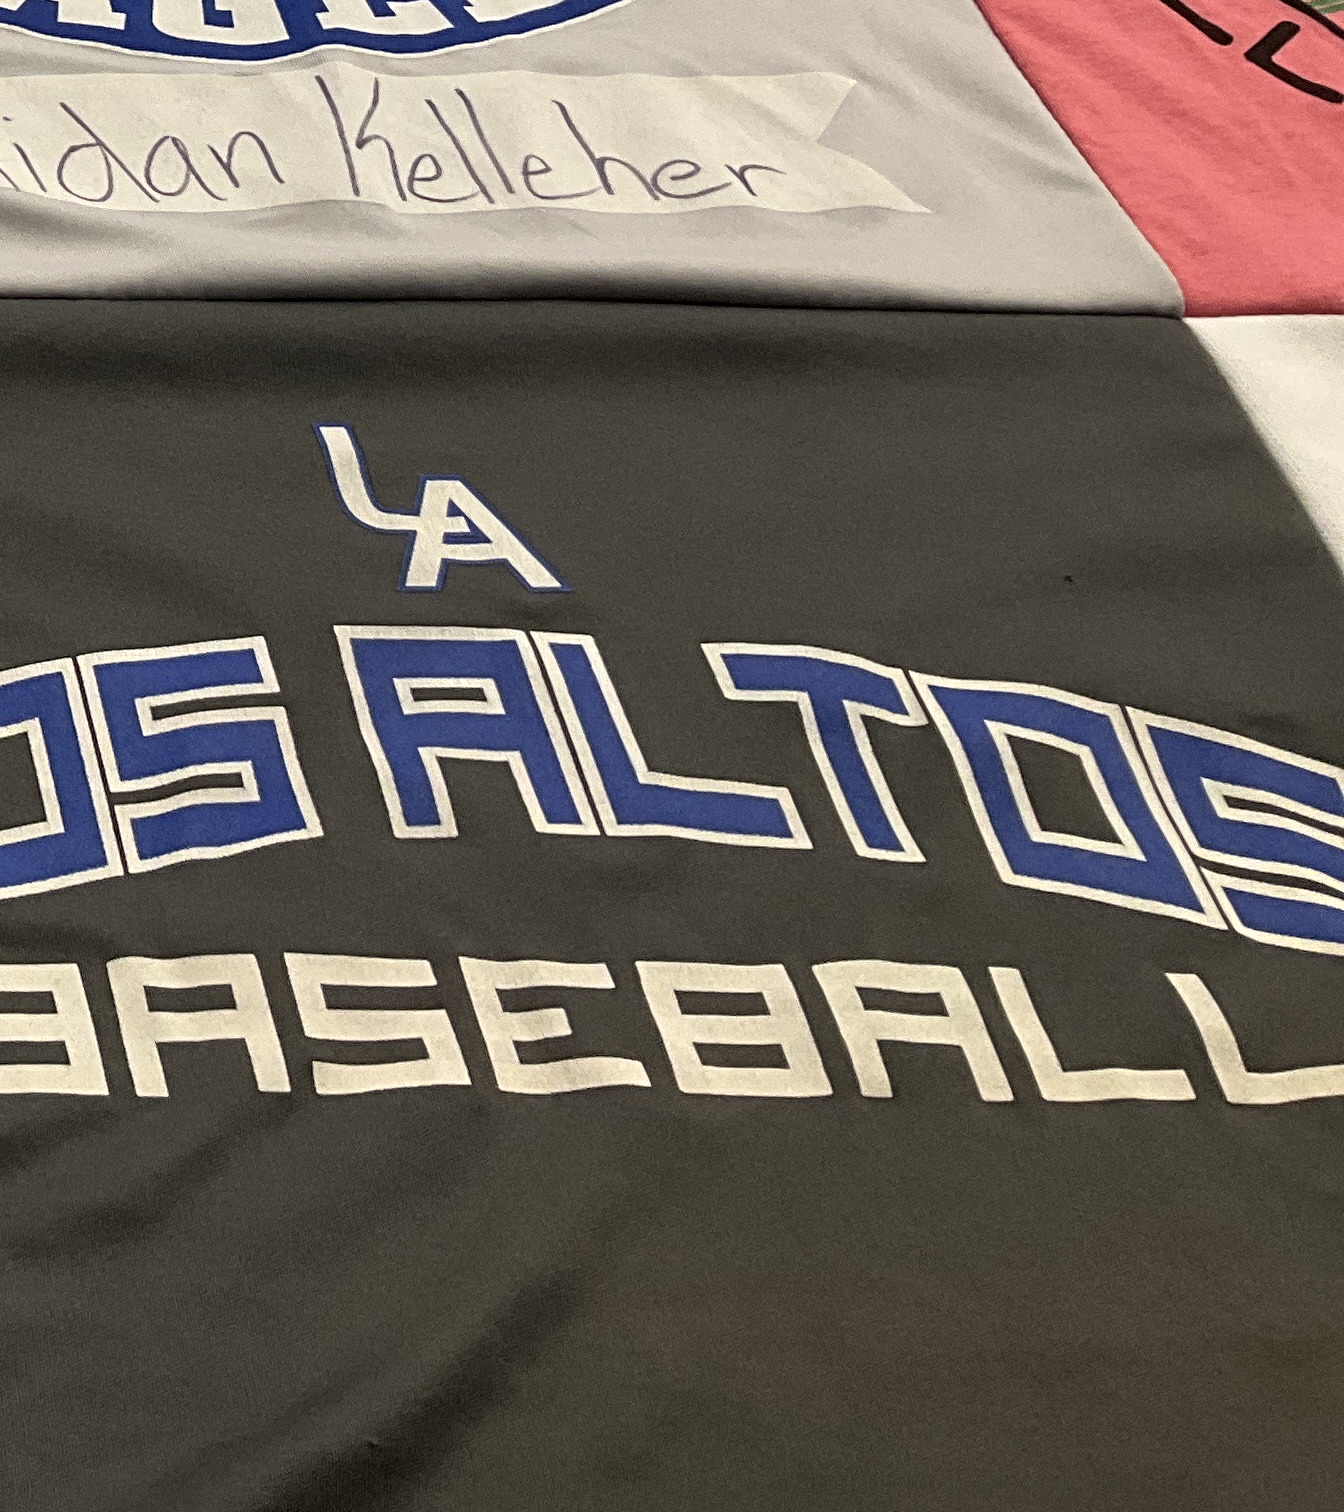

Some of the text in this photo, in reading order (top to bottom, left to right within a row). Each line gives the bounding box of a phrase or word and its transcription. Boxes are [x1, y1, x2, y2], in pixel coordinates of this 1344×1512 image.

[312, 72, 787, 210] Kelleher
[313, 422, 573, 593] LA
[331, 621, 1344, 959] ALTOS
